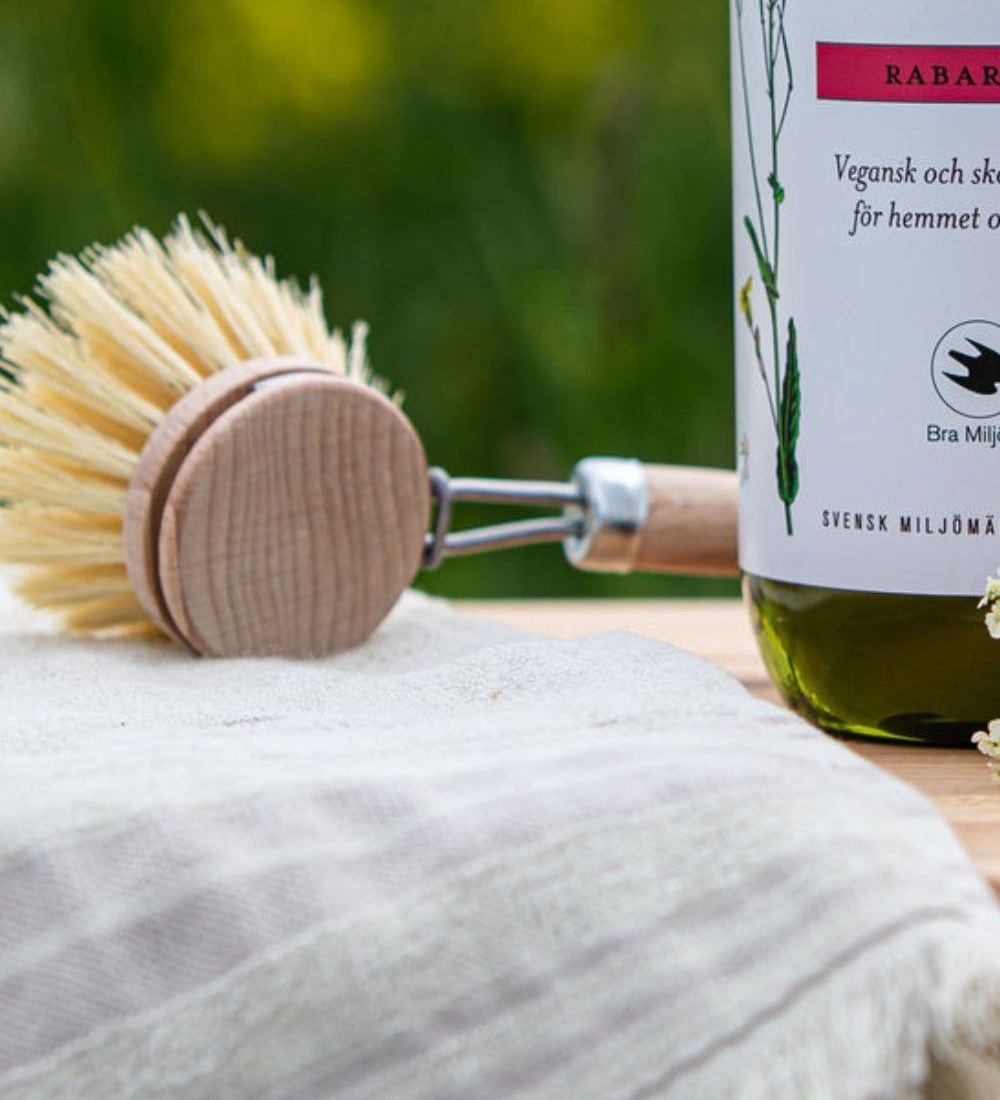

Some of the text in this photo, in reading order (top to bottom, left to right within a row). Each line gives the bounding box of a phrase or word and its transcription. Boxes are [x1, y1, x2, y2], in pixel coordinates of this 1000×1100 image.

[834, 153, 918, 193] Vegansk
[923, 157, 964, 185] och
[848, 199, 884, 237] för
[888, 200, 981, 230] hemmet
[926, 424, 959, 443] Bra
[822, 509, 888, 532] SVENSK
